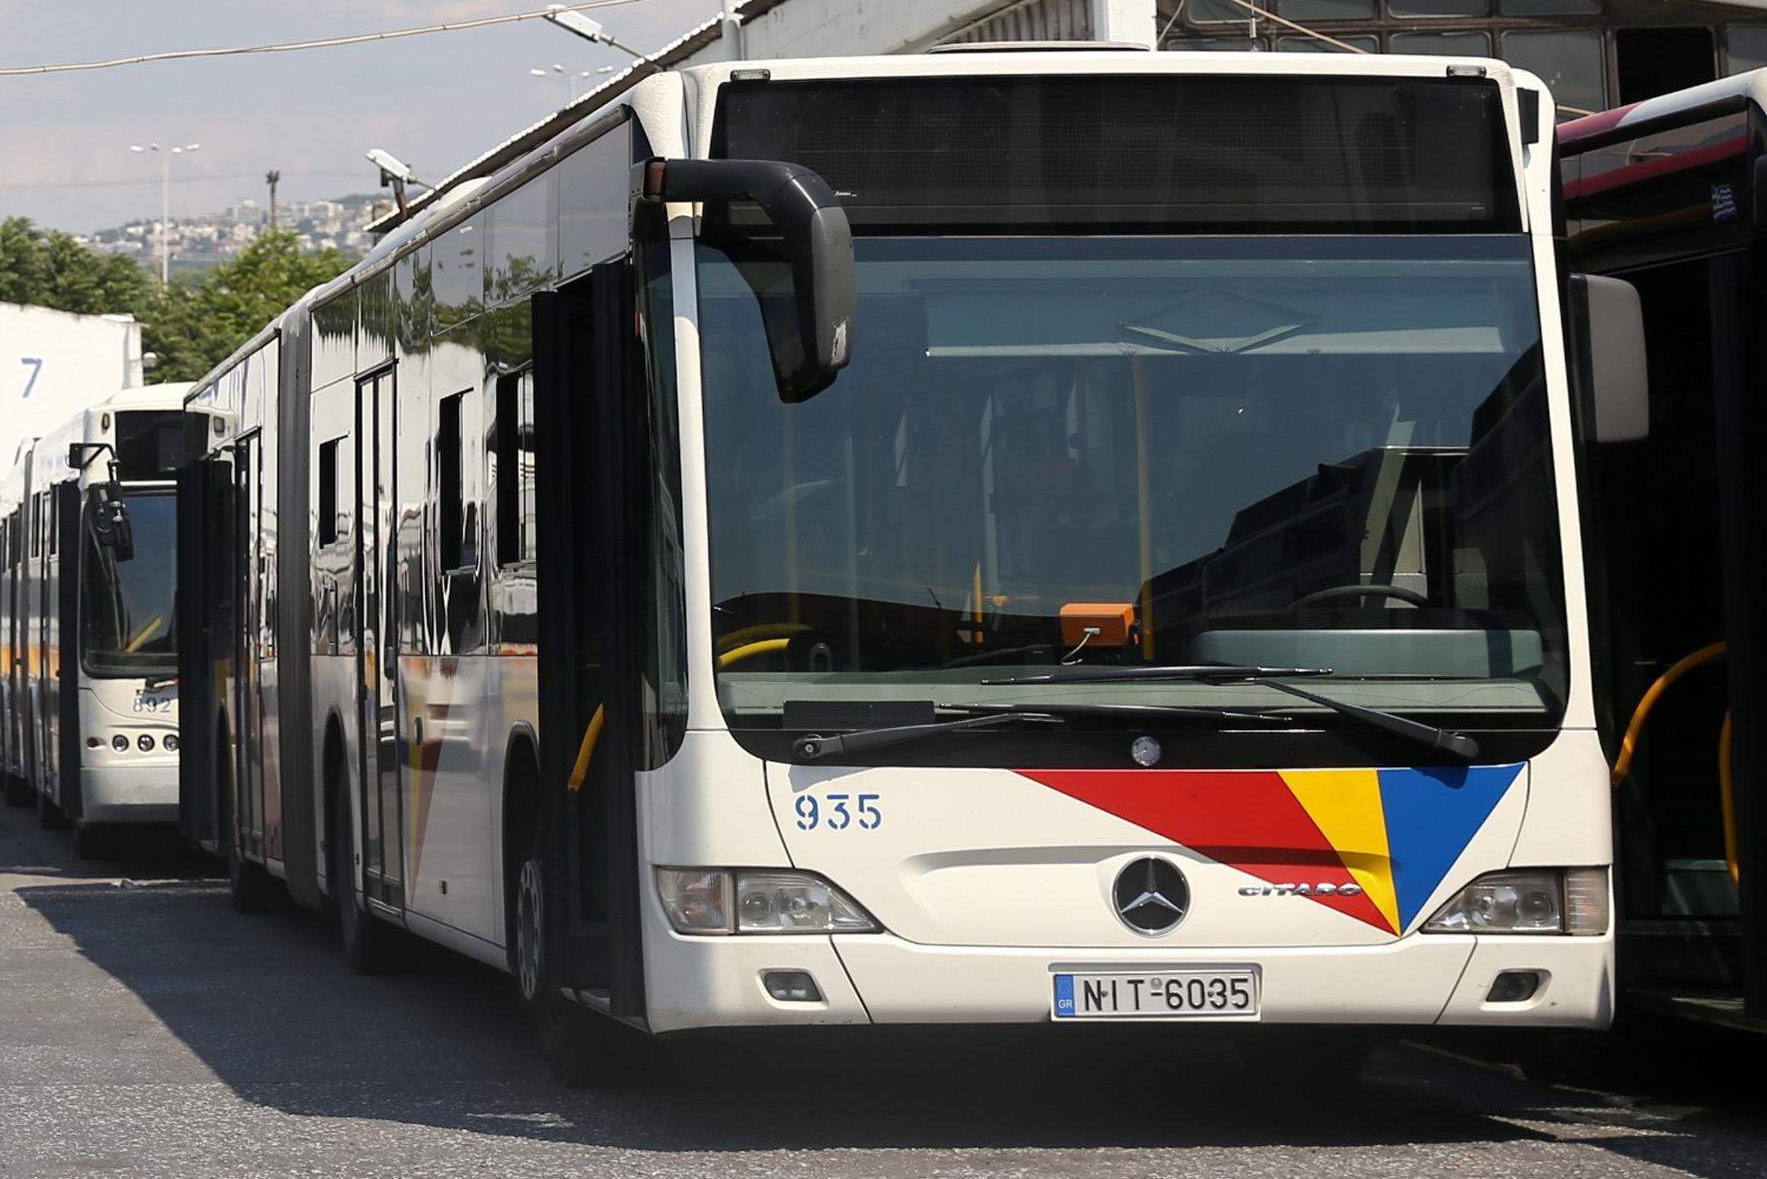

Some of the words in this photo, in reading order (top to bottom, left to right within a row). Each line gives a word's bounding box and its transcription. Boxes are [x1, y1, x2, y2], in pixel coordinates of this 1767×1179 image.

[20, 358, 42, 398] 7
[133, 697, 172, 713] 892
[795, 794, 882, 830] 935
[1238, 882, 1362, 896] CITARO
[1058, 999, 1073, 1009] GR
